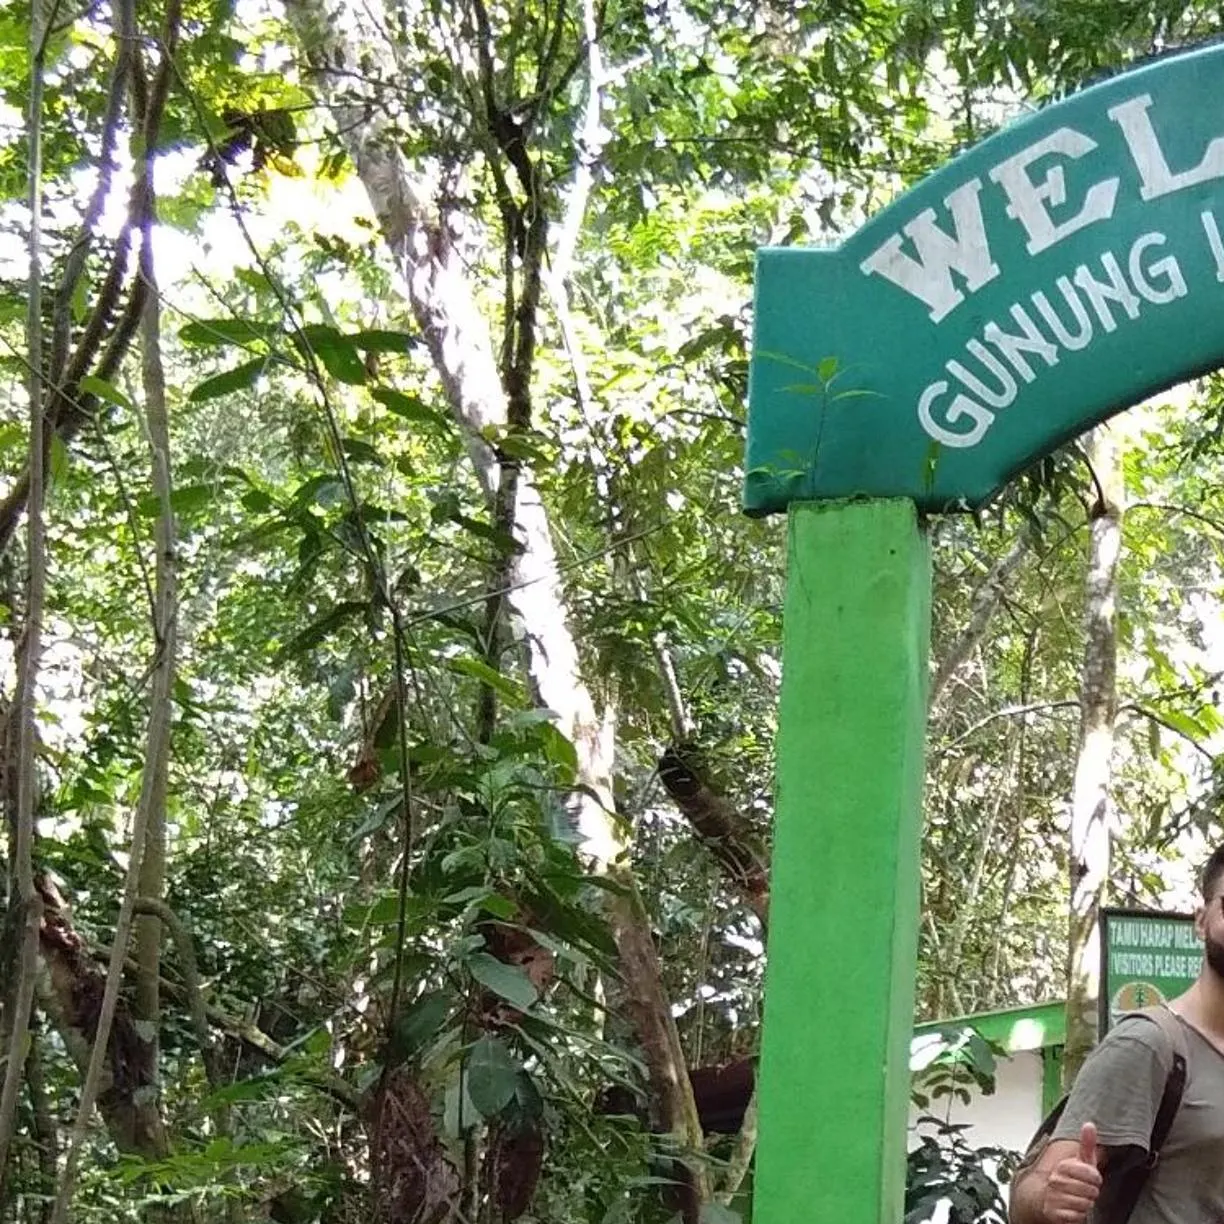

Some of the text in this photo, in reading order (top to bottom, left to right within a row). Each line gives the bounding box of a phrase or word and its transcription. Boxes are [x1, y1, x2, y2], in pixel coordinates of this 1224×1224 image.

[917, 232, 1188, 448] GUNUNG
[1111, 952, 1154, 977] VISITORS
[1155, 954, 1187, 978] PLEASE
